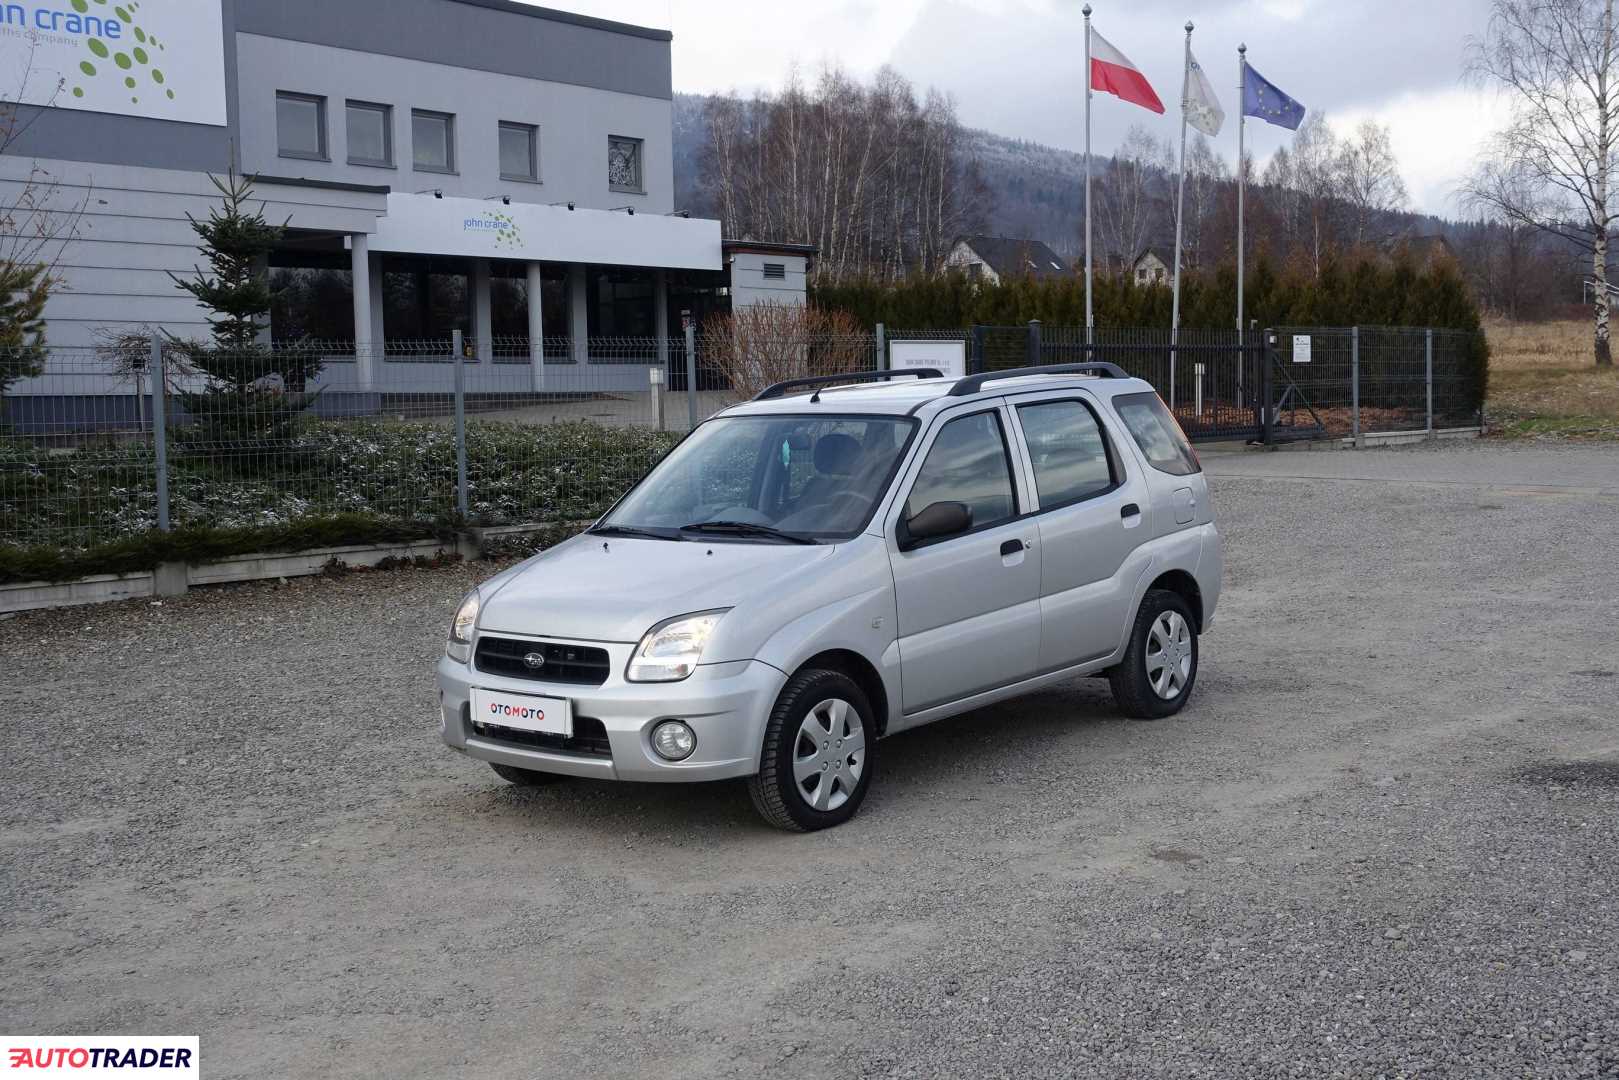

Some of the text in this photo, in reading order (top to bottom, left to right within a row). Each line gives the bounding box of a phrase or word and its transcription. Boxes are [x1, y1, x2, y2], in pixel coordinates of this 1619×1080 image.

[35, 9, 121, 39] crane
[463, 217, 508, 231] john crane
[490, 703, 545, 721] OTOMOTO
